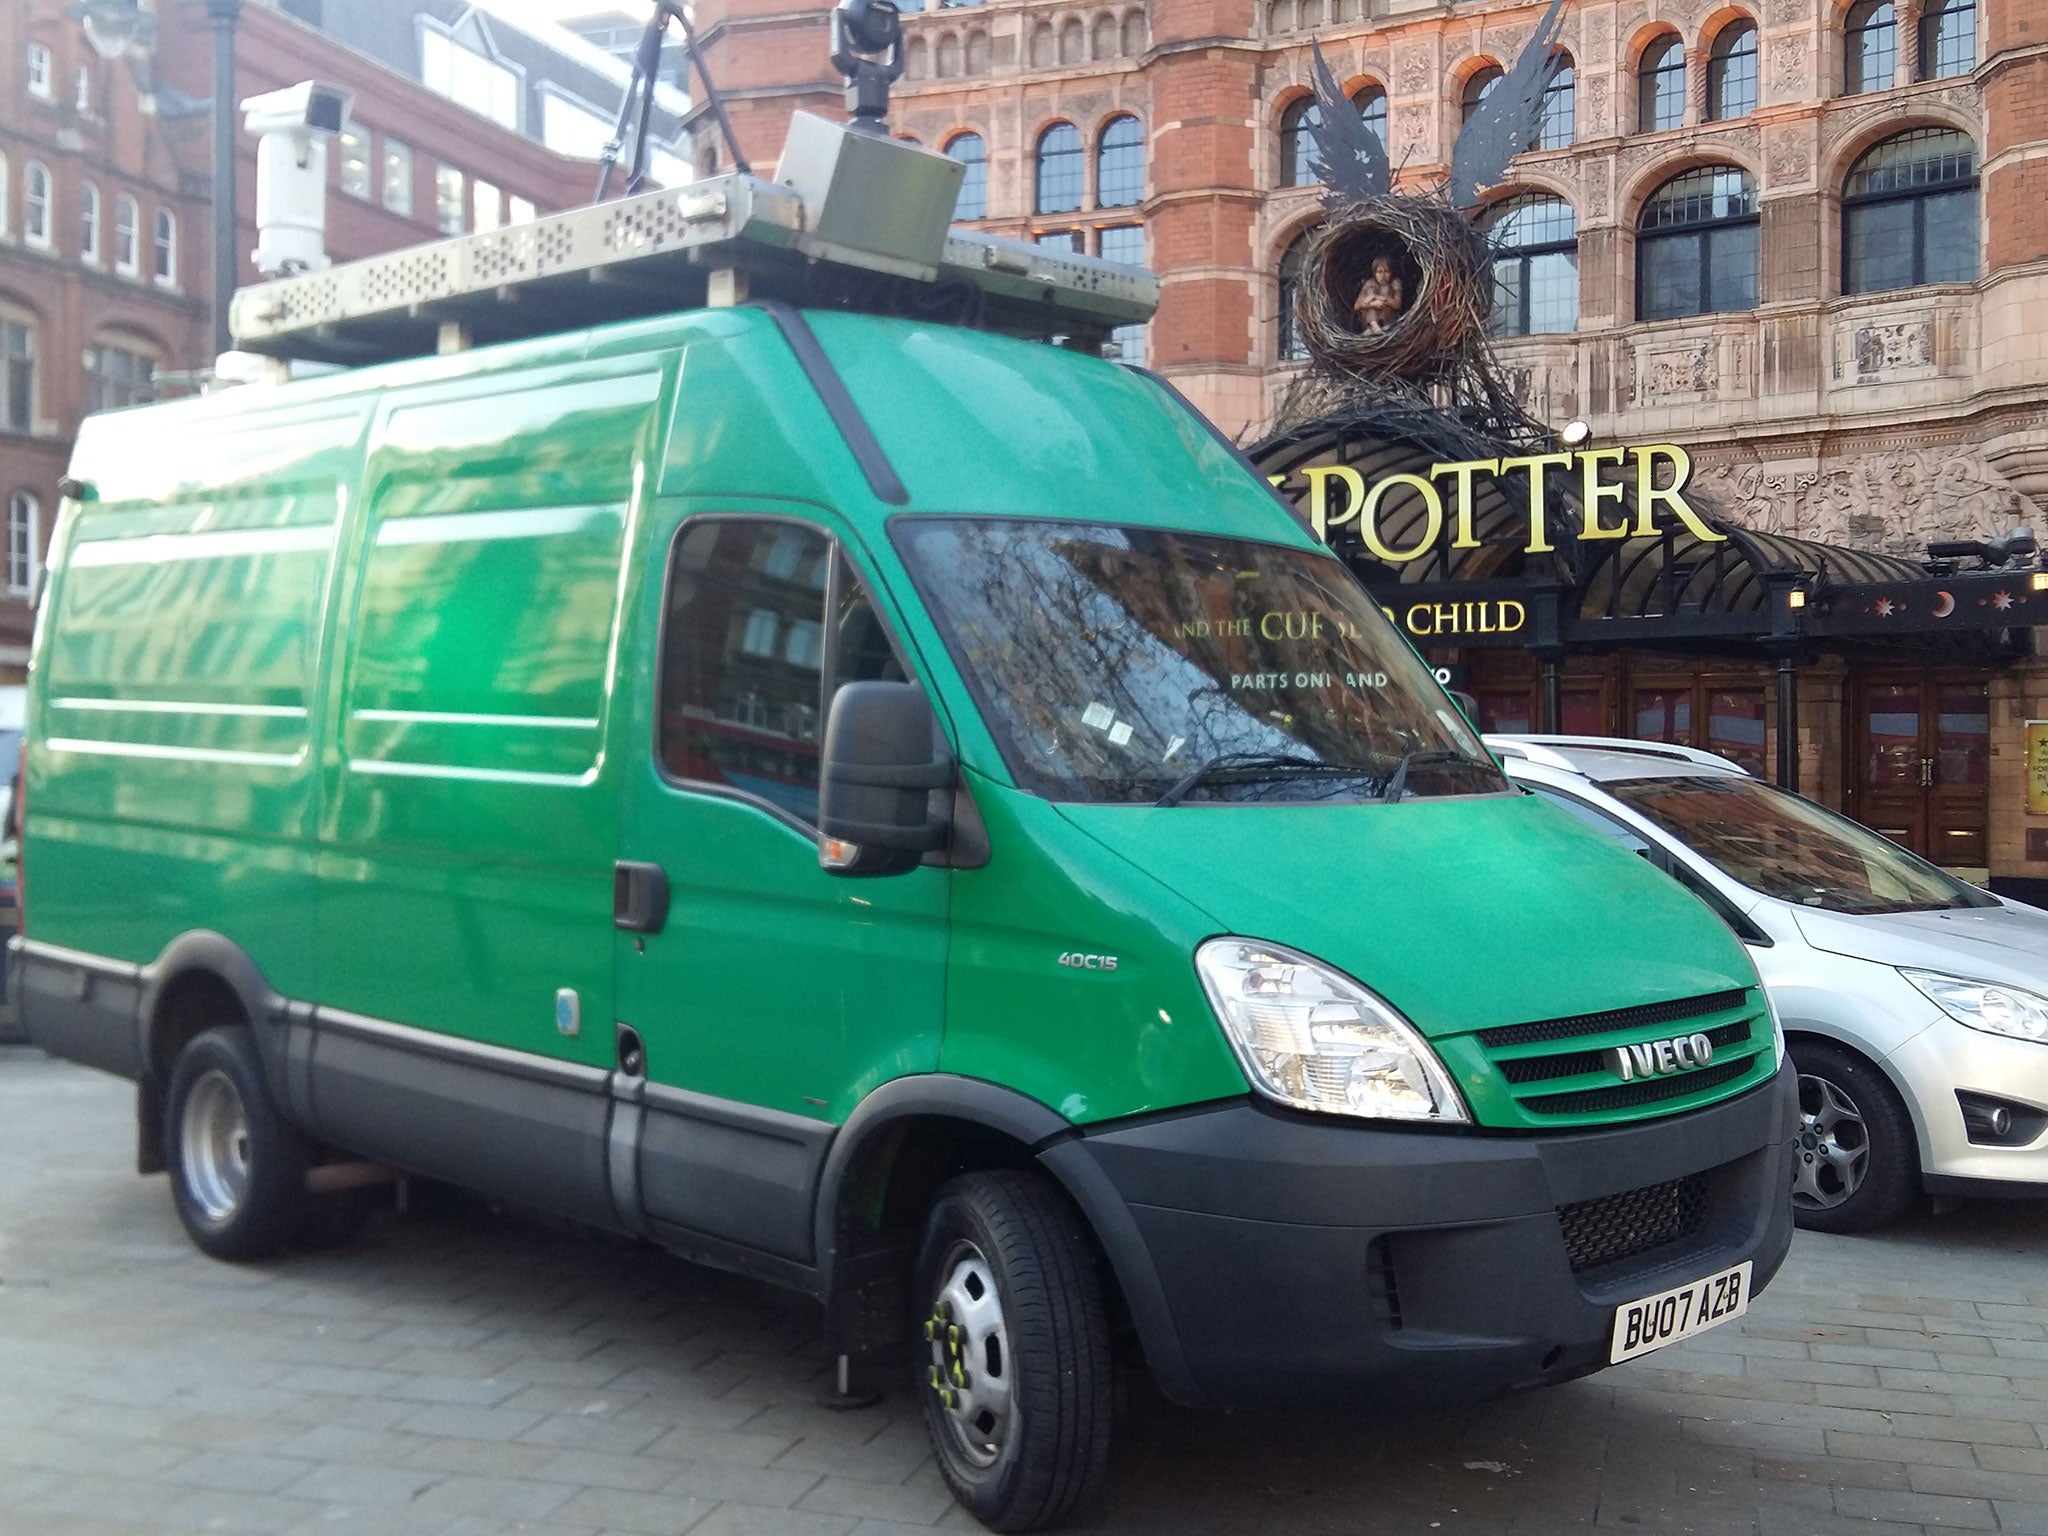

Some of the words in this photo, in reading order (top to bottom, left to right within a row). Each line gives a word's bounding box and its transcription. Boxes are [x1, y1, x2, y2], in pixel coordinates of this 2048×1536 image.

[1301, 443, 1728, 562] POTTER
[1216, 619, 1251, 637] THE
[1406, 601, 1526, 635] CHILD
[1231, 673, 1288, 689] PARTS
[1058, 952, 1118, 972] 40C15
[1615, 1033, 1713, 1081] IVECO
[1624, 1289, 1694, 1352] BU07
[1696, 1271, 1742, 1326] AZB
